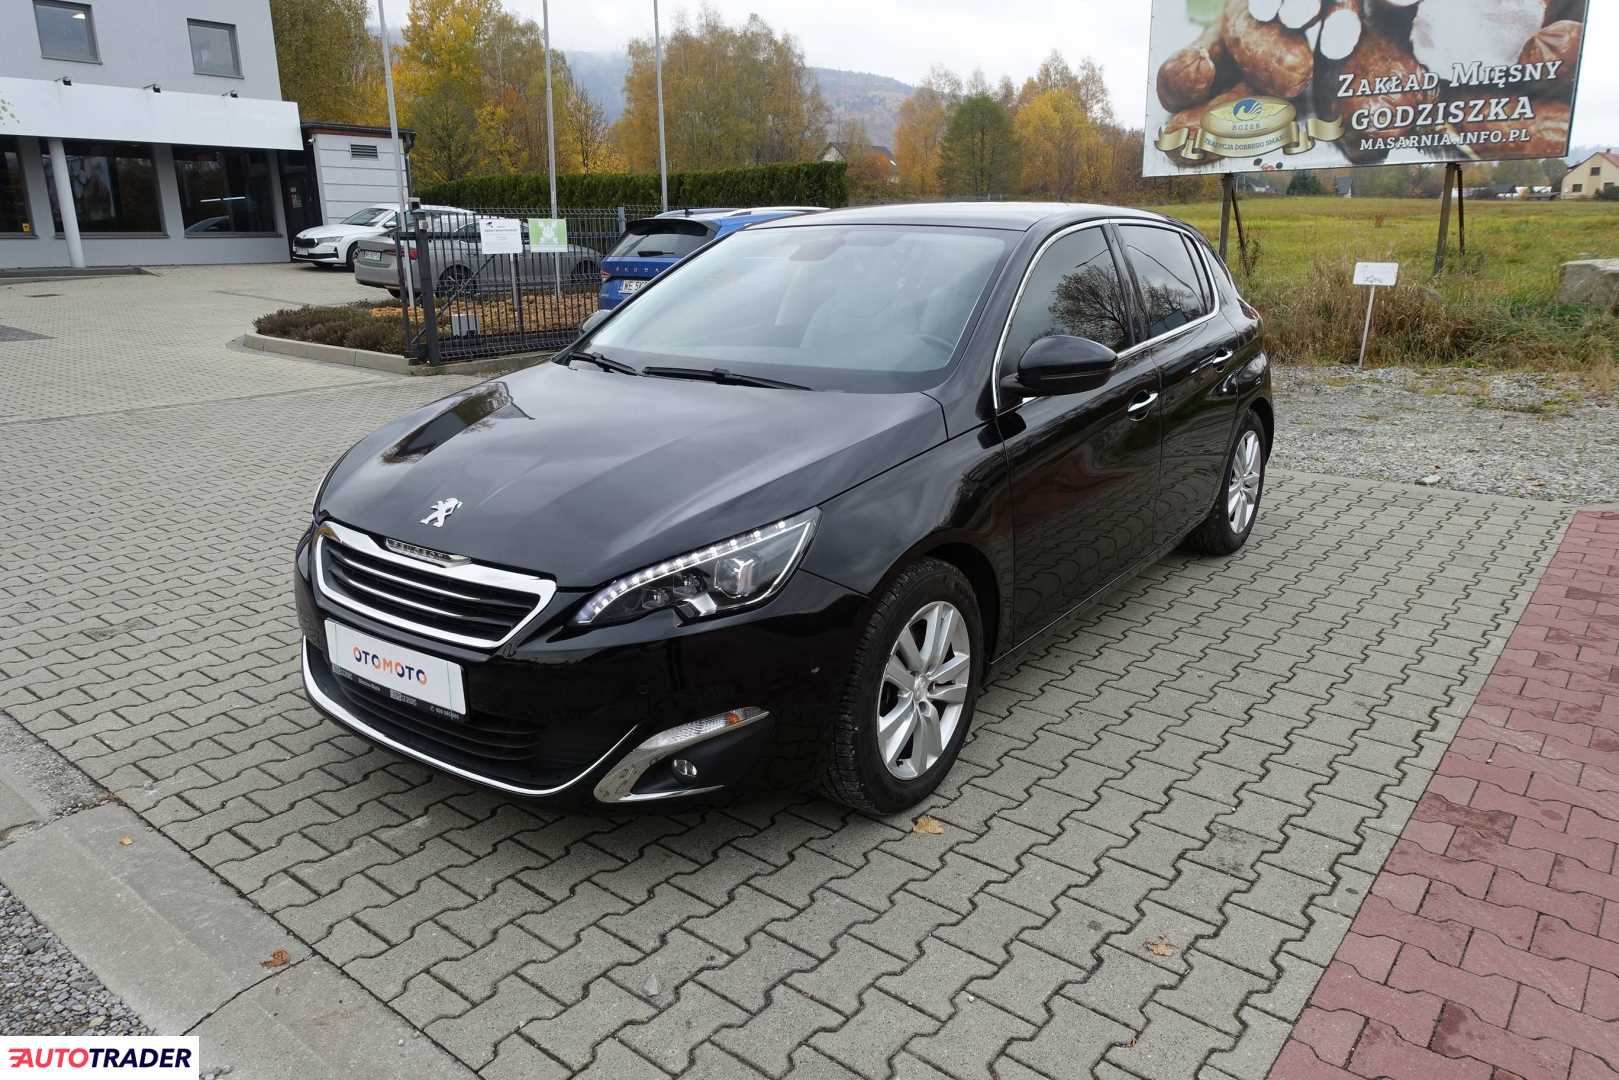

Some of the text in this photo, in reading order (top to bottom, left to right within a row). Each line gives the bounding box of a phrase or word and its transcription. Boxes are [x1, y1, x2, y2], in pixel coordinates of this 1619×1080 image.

[1337, 60, 1562, 97] ZAKŁAD MIĘSNY
[1351, 96, 1535, 131] GODZISZKA
[1359, 129, 1530, 151] MASARNIA.INFO.PL
[352, 645, 428, 685] OTOMOTO
